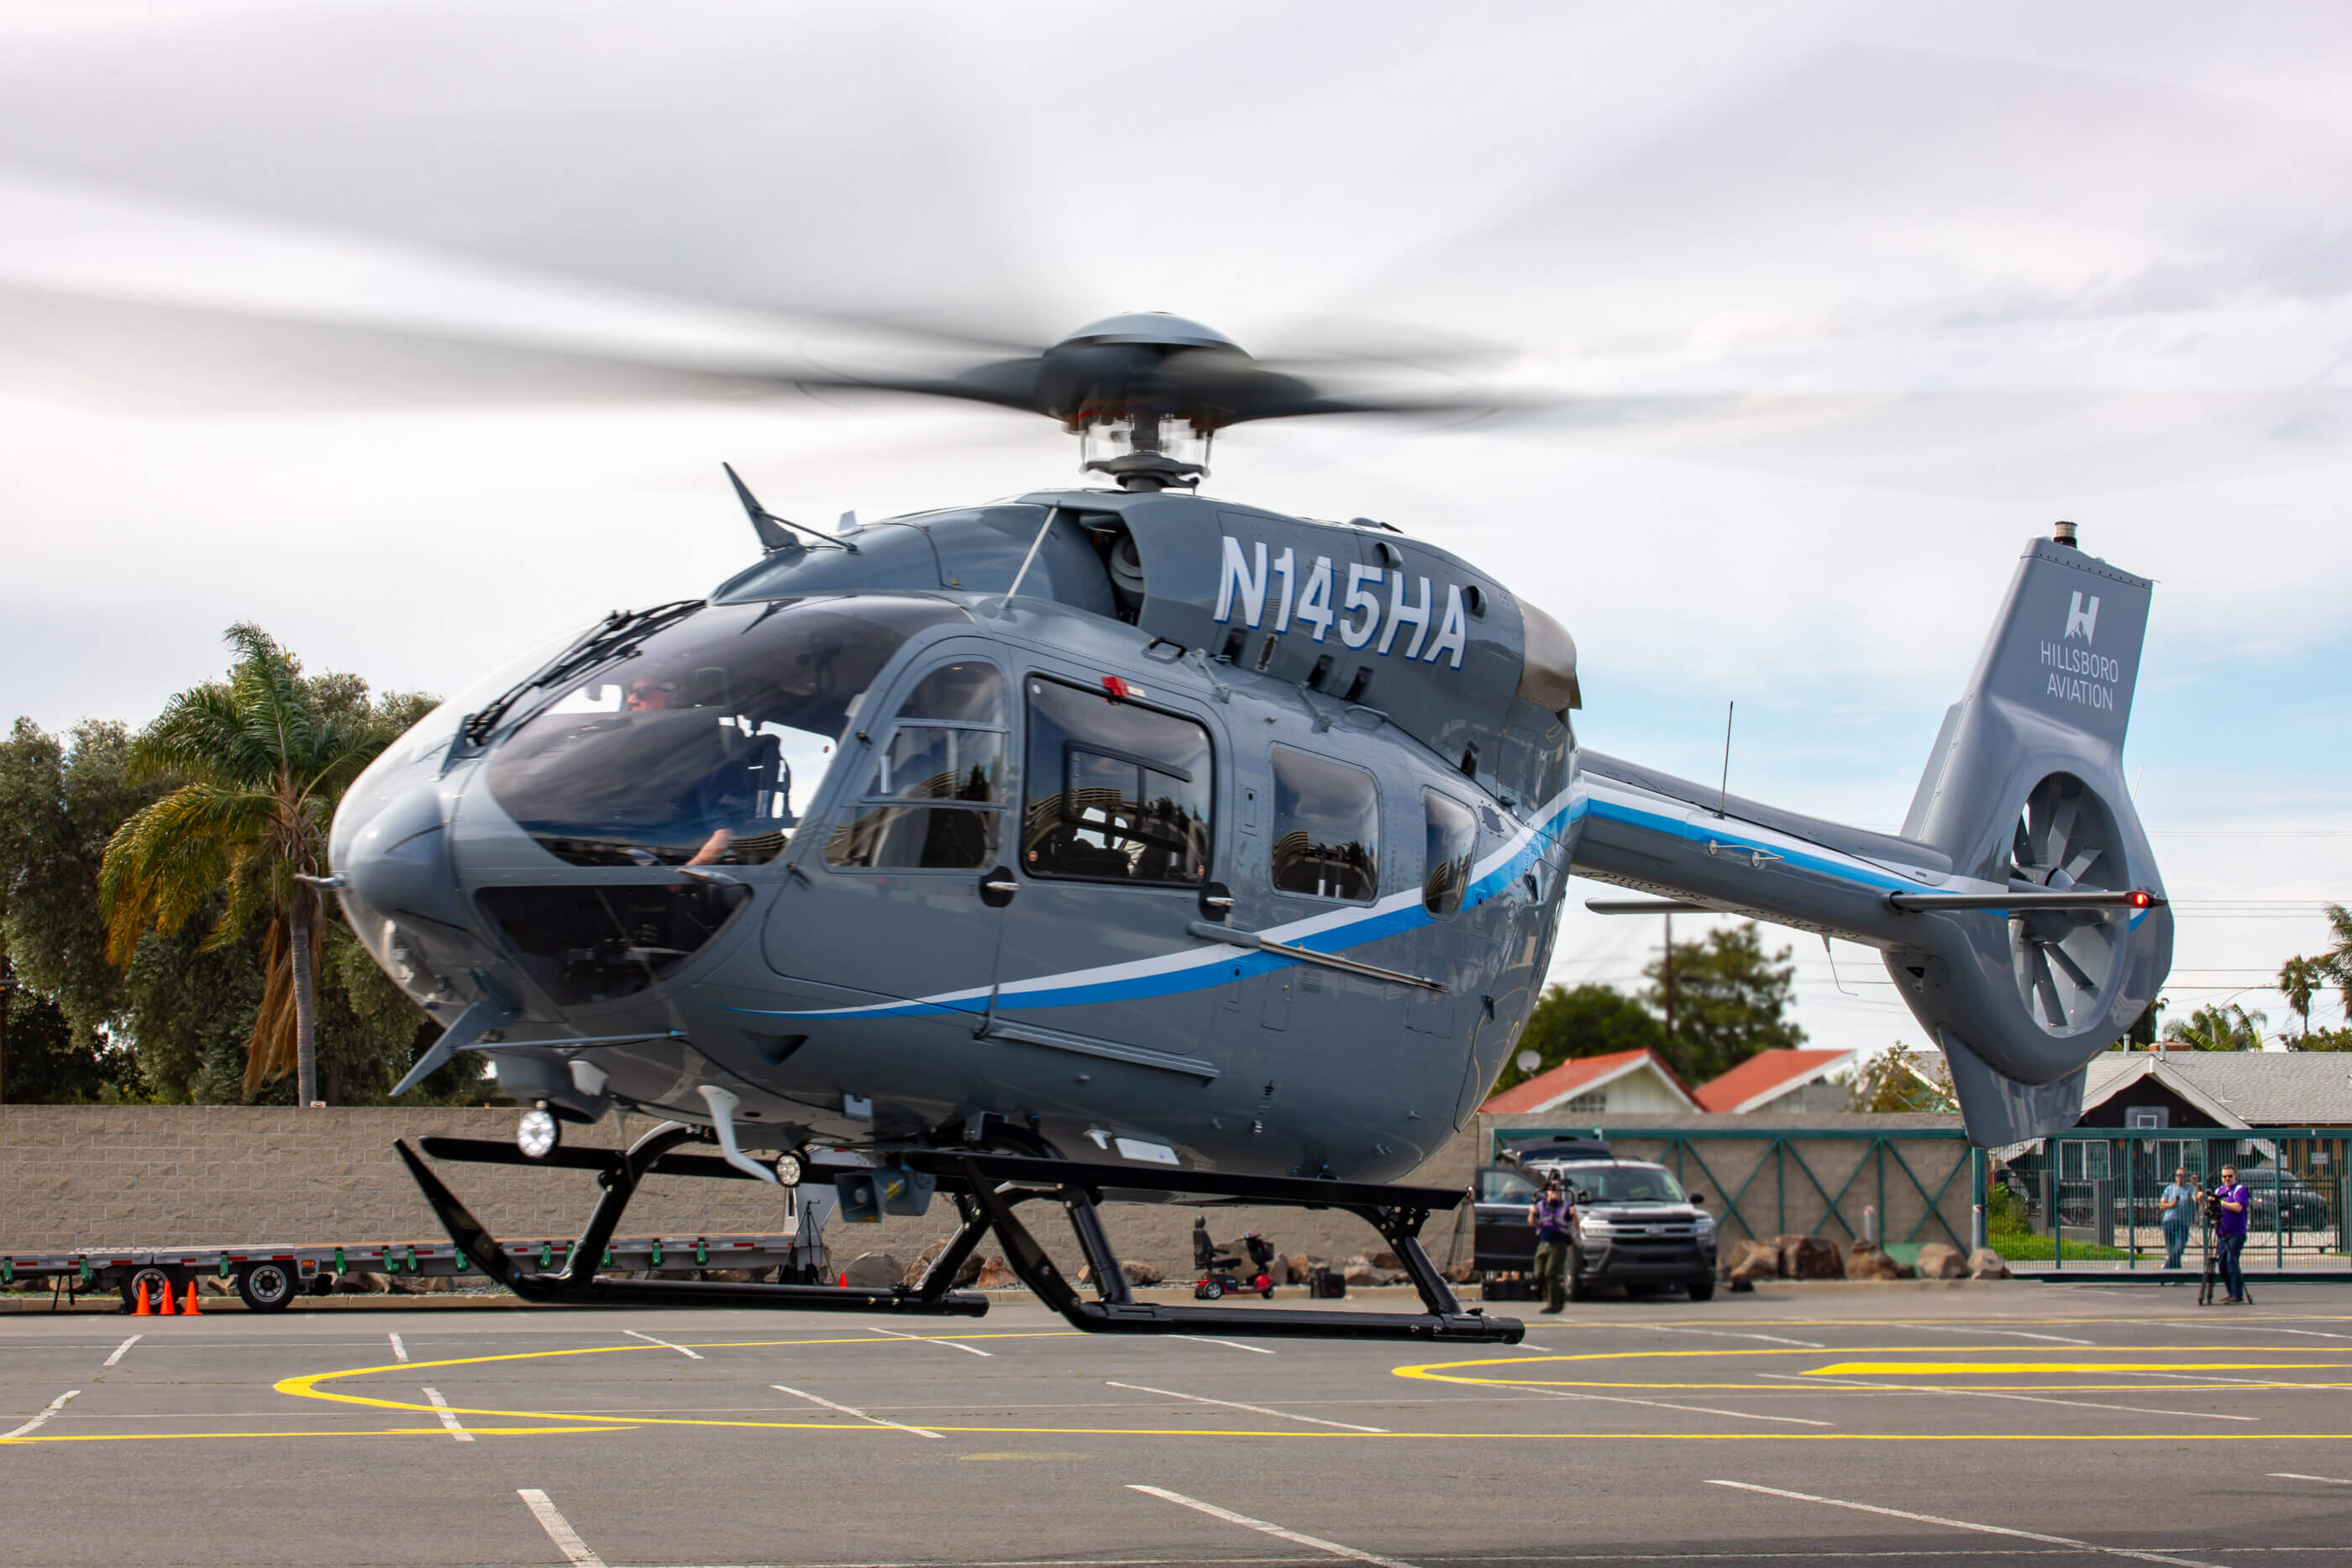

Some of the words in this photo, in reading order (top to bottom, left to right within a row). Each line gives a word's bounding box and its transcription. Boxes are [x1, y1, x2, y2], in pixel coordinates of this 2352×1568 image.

[1214, 536, 1467, 670] N145HA
[2040, 640, 2119, 683] HILLSBORO
[2046, 673, 2113, 711] AVIATION
